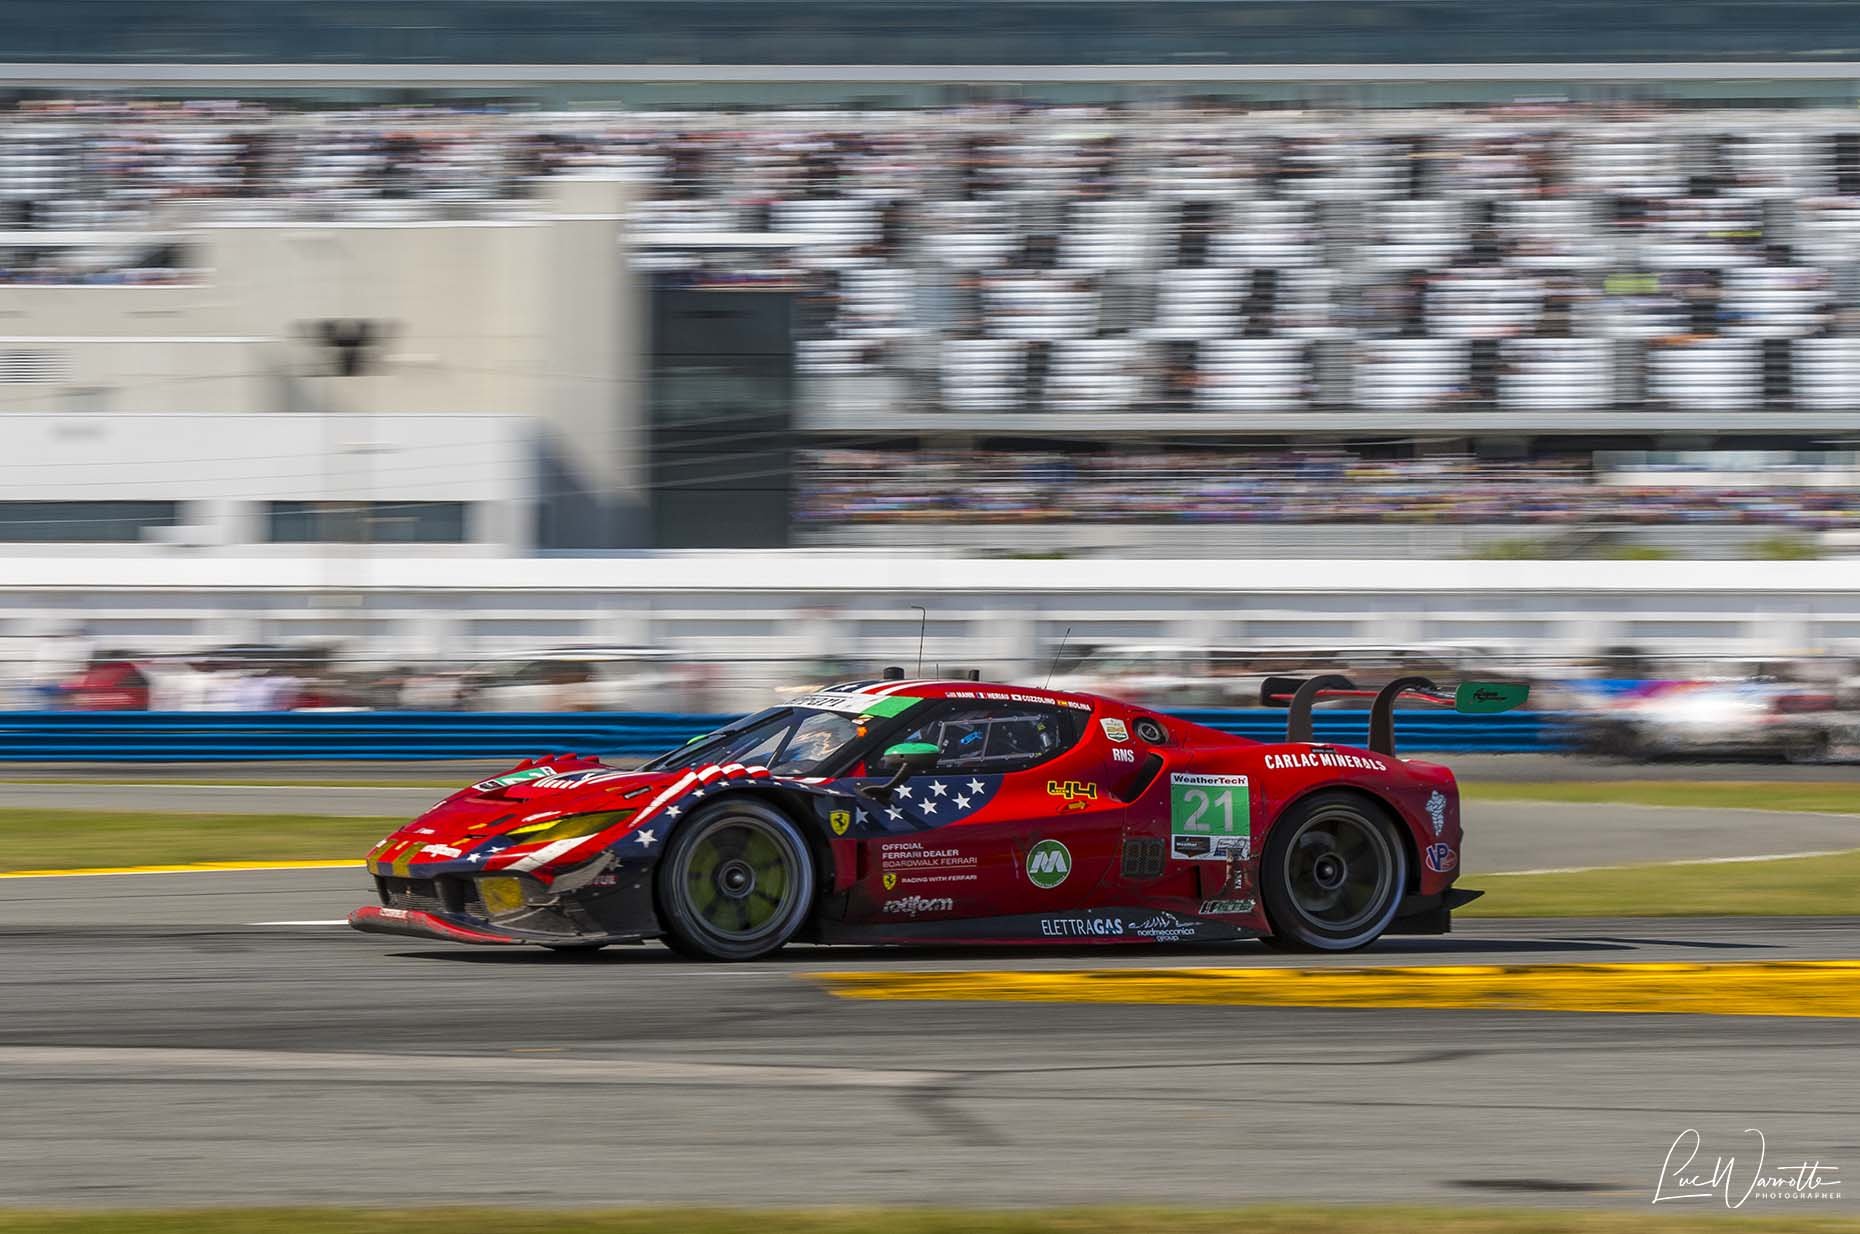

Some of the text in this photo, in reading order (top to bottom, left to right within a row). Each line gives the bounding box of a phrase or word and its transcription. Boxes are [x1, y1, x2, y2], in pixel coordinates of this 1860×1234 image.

[1112, 748, 1135, 763] RNS
[1264, 753, 1387, 771] CARLAC MINERALS
[1174, 774, 1246, 785] WeatherTech
[1048, 781, 1097, 800] 44
[1184, 789, 1233, 833] 21
[882, 843, 924, 851] OFFICIAL
[882, 849, 960, 860] FERRARI DEALER
[882, 857, 978, 868] BOARDWALK FERRARI
[1426, 842, 1450, 871] VP
[948, 874, 978, 882] FERRARI
[883, 896, 953, 917] rotiform
[1041, 918, 1124, 936] ELETTRAGAS
